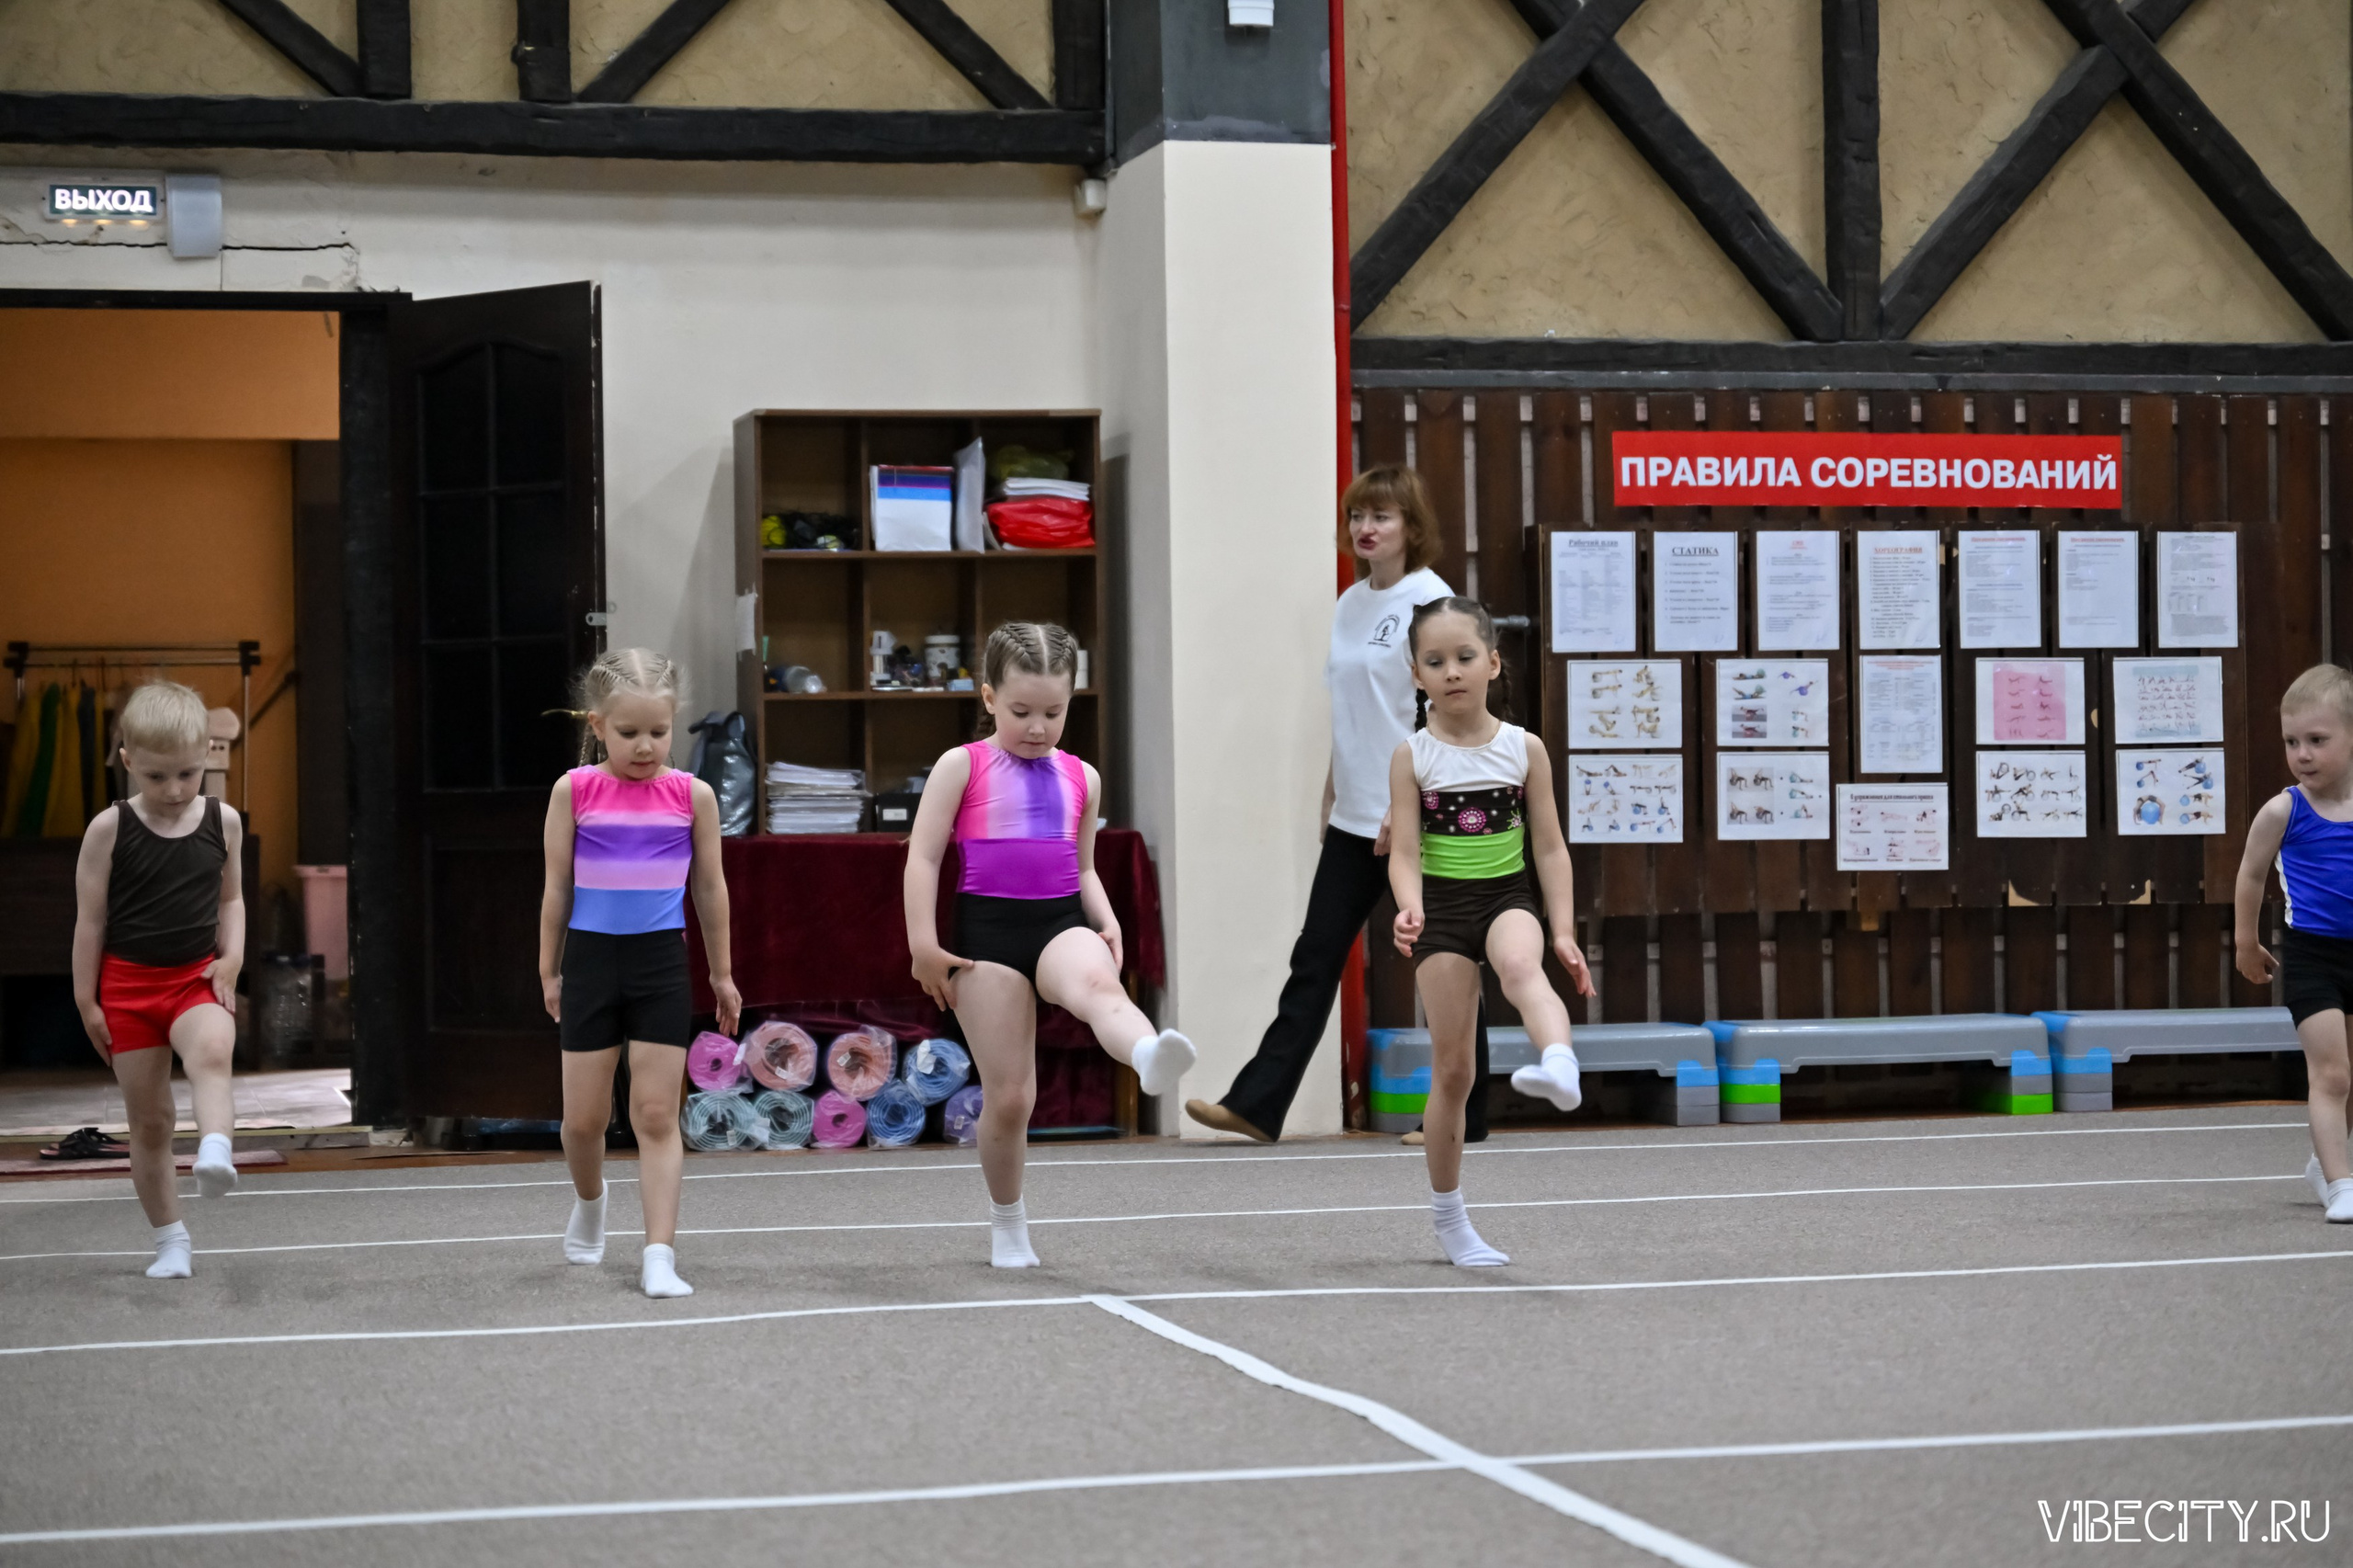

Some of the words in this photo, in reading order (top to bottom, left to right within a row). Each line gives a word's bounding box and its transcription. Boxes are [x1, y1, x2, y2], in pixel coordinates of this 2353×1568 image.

[55, 188, 153, 212] ВЫХОД
[1621, 457, 1802, 486] ПРАВИЛА
[1811, 454, 2116, 490] СОРЕВНОВАНИЙ
[1672, 547, 1719, 555] СТАТИКА
